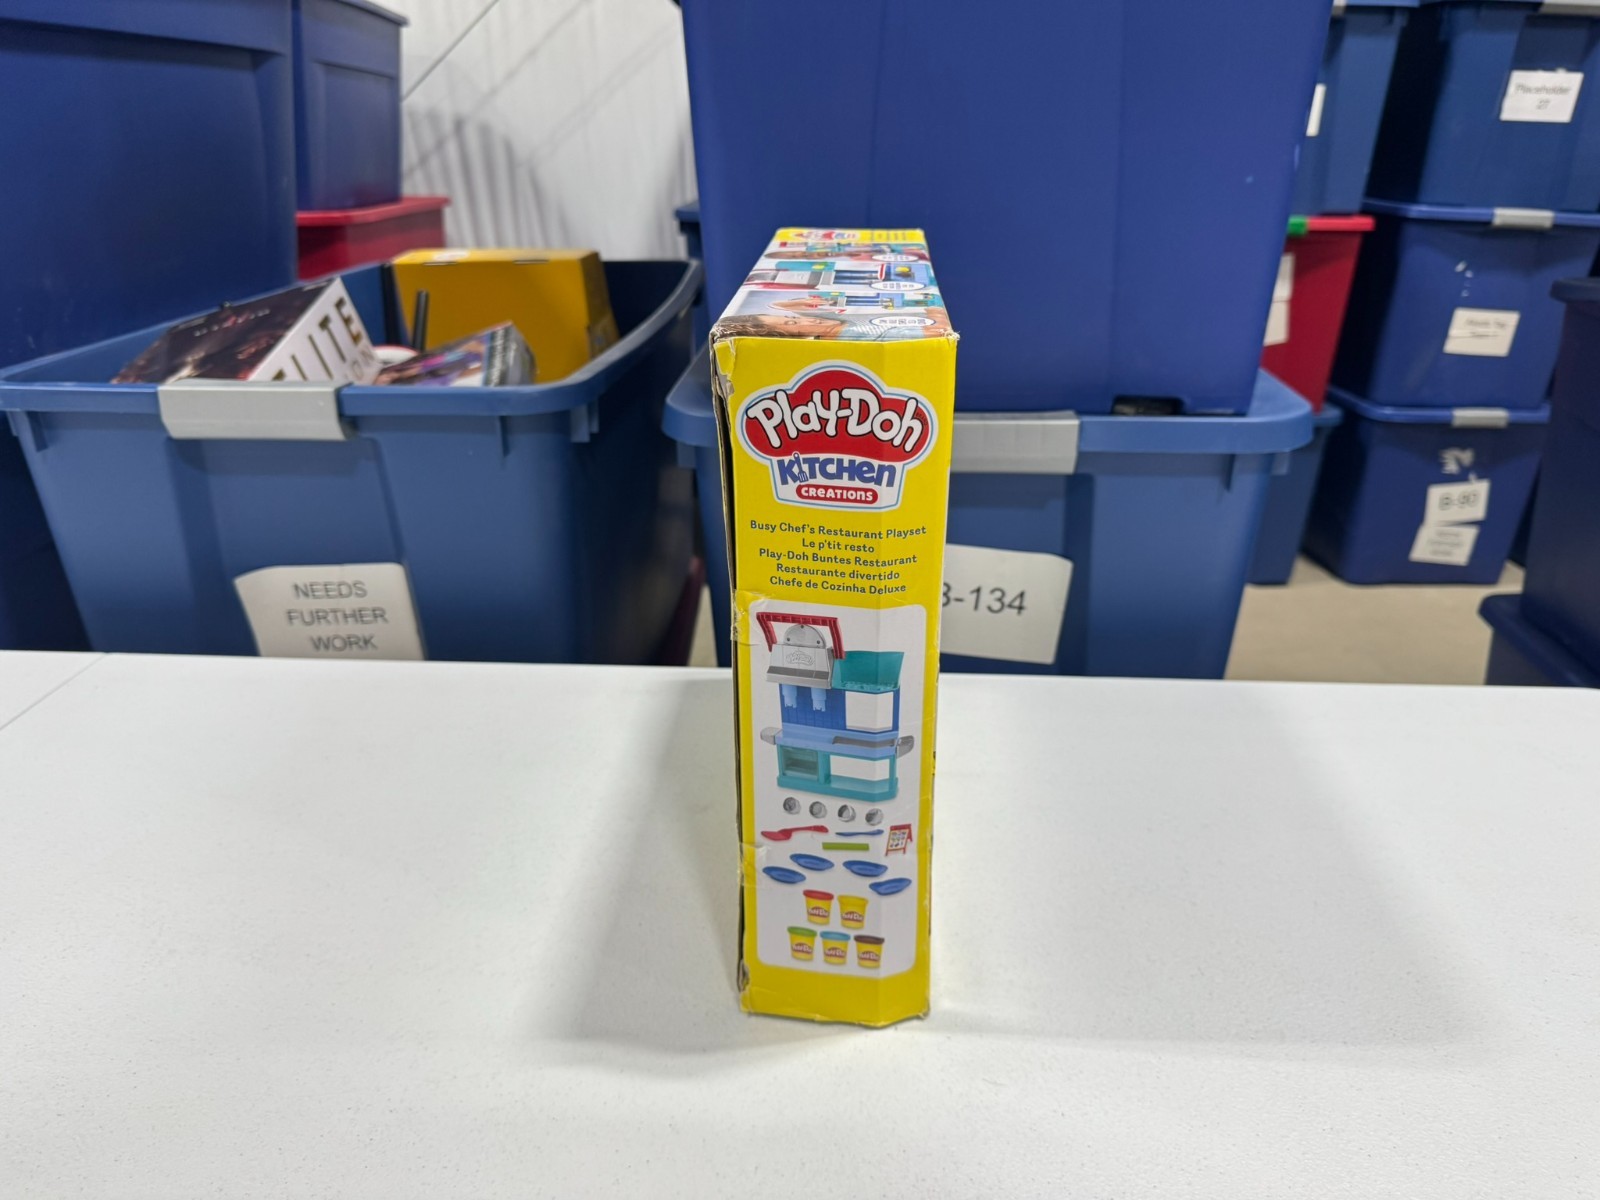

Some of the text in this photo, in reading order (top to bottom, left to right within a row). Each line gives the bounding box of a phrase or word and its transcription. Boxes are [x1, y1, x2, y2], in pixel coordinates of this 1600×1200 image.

[746, 388, 923, 452] Play-Doh
[750, 520, 927, 539] Busy Chef's Restaurant Playset
[802, 538, 875, 553] Le p'tit resto
[759, 548, 917, 567] Play-Doh Buntes Restaurant
[776, 563, 900, 581] Restaurante divertido
[292, 580, 368, 599] NEEDS
[770, 576, 907, 595] Chefe de Cozinha Deluxe
[286, 607, 389, 627] FURTHER
[310, 634, 378, 652] WORK
